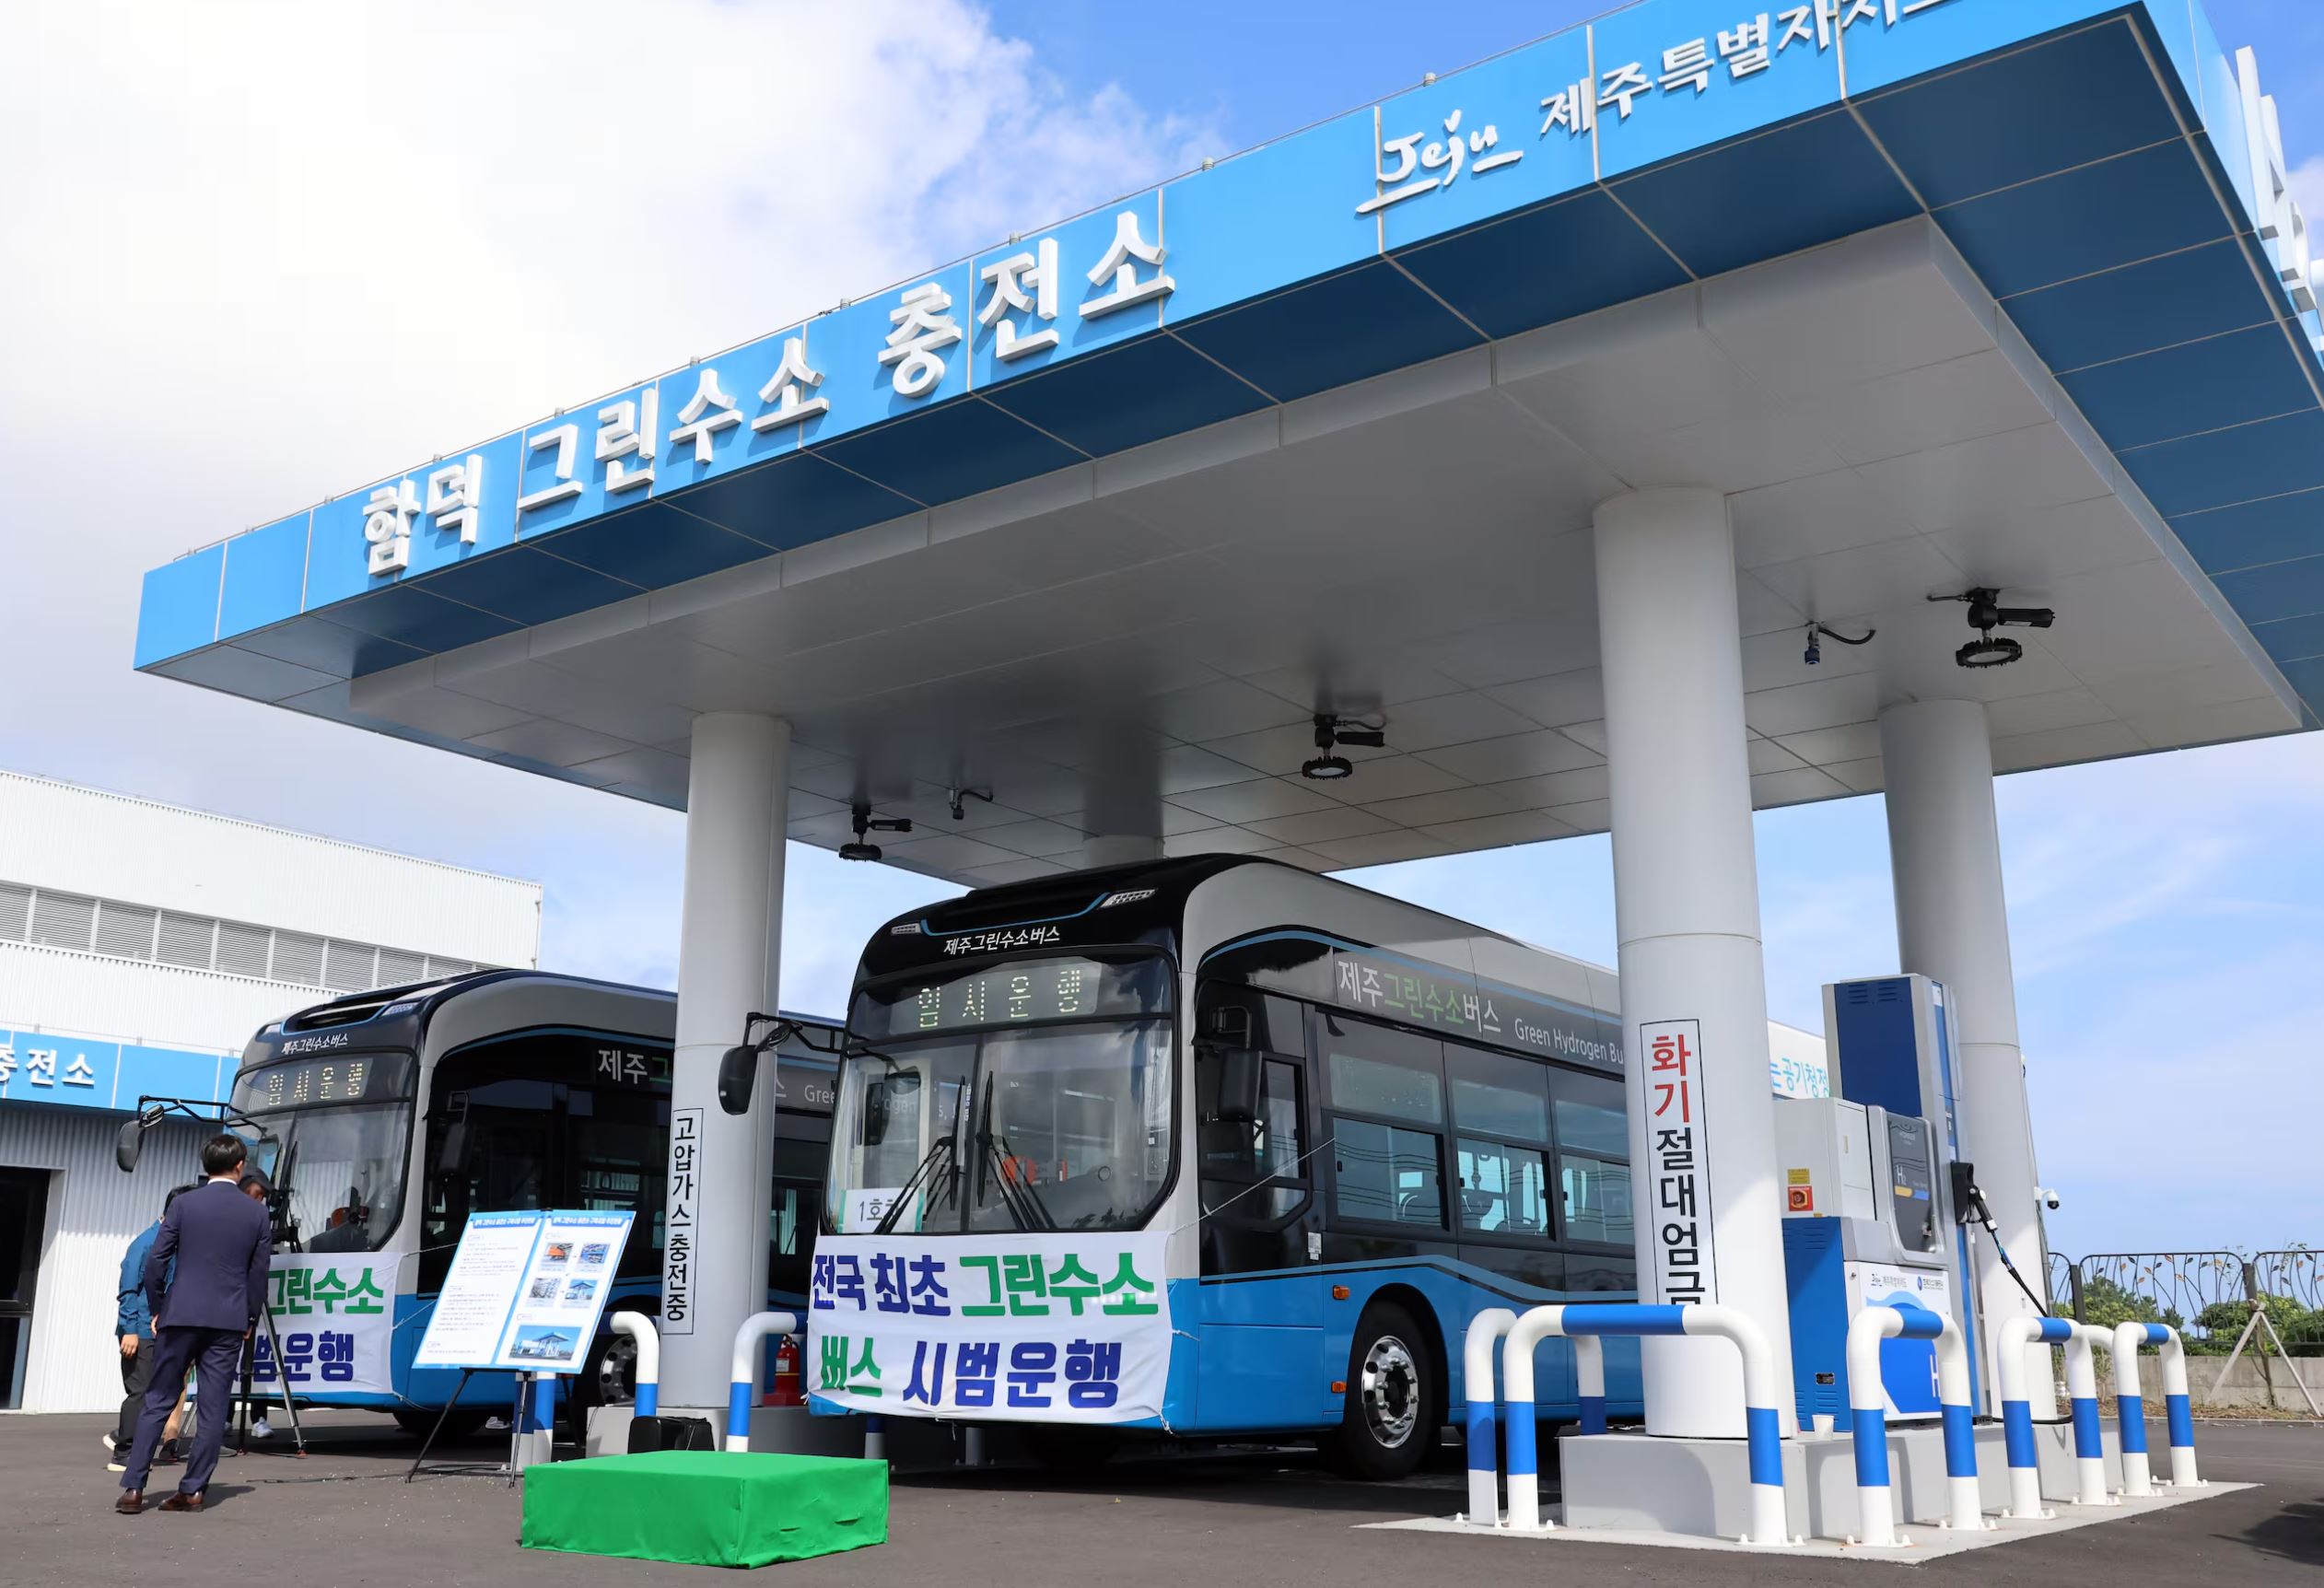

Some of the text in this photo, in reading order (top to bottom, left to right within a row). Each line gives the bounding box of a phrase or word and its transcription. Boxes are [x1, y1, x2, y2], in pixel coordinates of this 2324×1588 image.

[1537, 0, 1948, 137] 제주특별자
[1356, 109, 1524, 215] Jeju
[362, 210, 1175, 577] 함덕 그린수소 충전소
[943, 926, 1060, 955] 제주그린수소버스
[1338, 961, 1501, 1033] 제주그린수소버스
[1514, 1018, 1624, 1065] Green Hydrogen Bu
[804, 1084, 835, 1103] Gree
[267, 1267, 384, 1315] 그린수소
[813, 1252, 1159, 1316] 전국 최초 그린수소
[233, 1330, 354, 1382] 범운행
[821, 1336, 1122, 1408] 버스 시범운행
